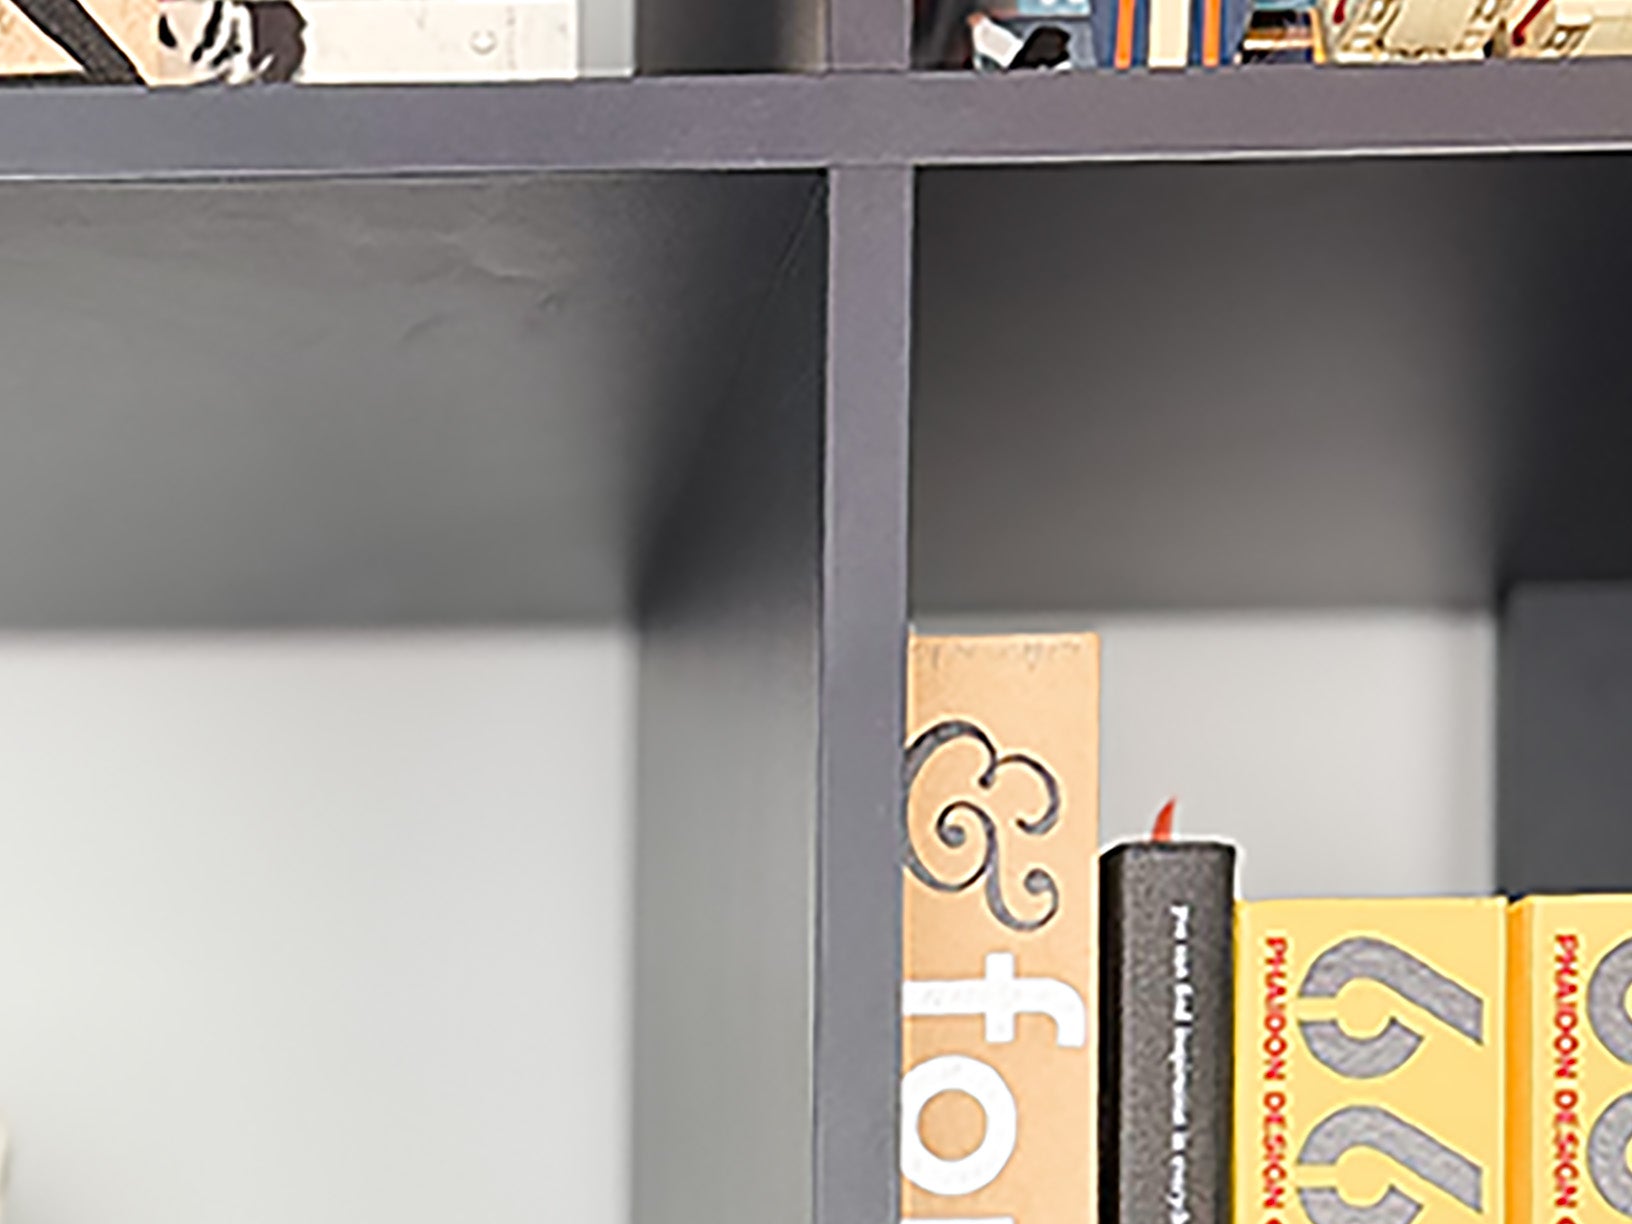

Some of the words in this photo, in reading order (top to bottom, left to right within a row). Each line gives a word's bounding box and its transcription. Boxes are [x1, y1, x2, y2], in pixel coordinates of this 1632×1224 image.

[1263, 936, 1288, 1081] PHAIDON
[1555, 934, 1580, 1079] PHAIDON
[1262, 1091, 1288, 1210] DESIGN
[1554, 1089, 1580, 1208] DESIGN
